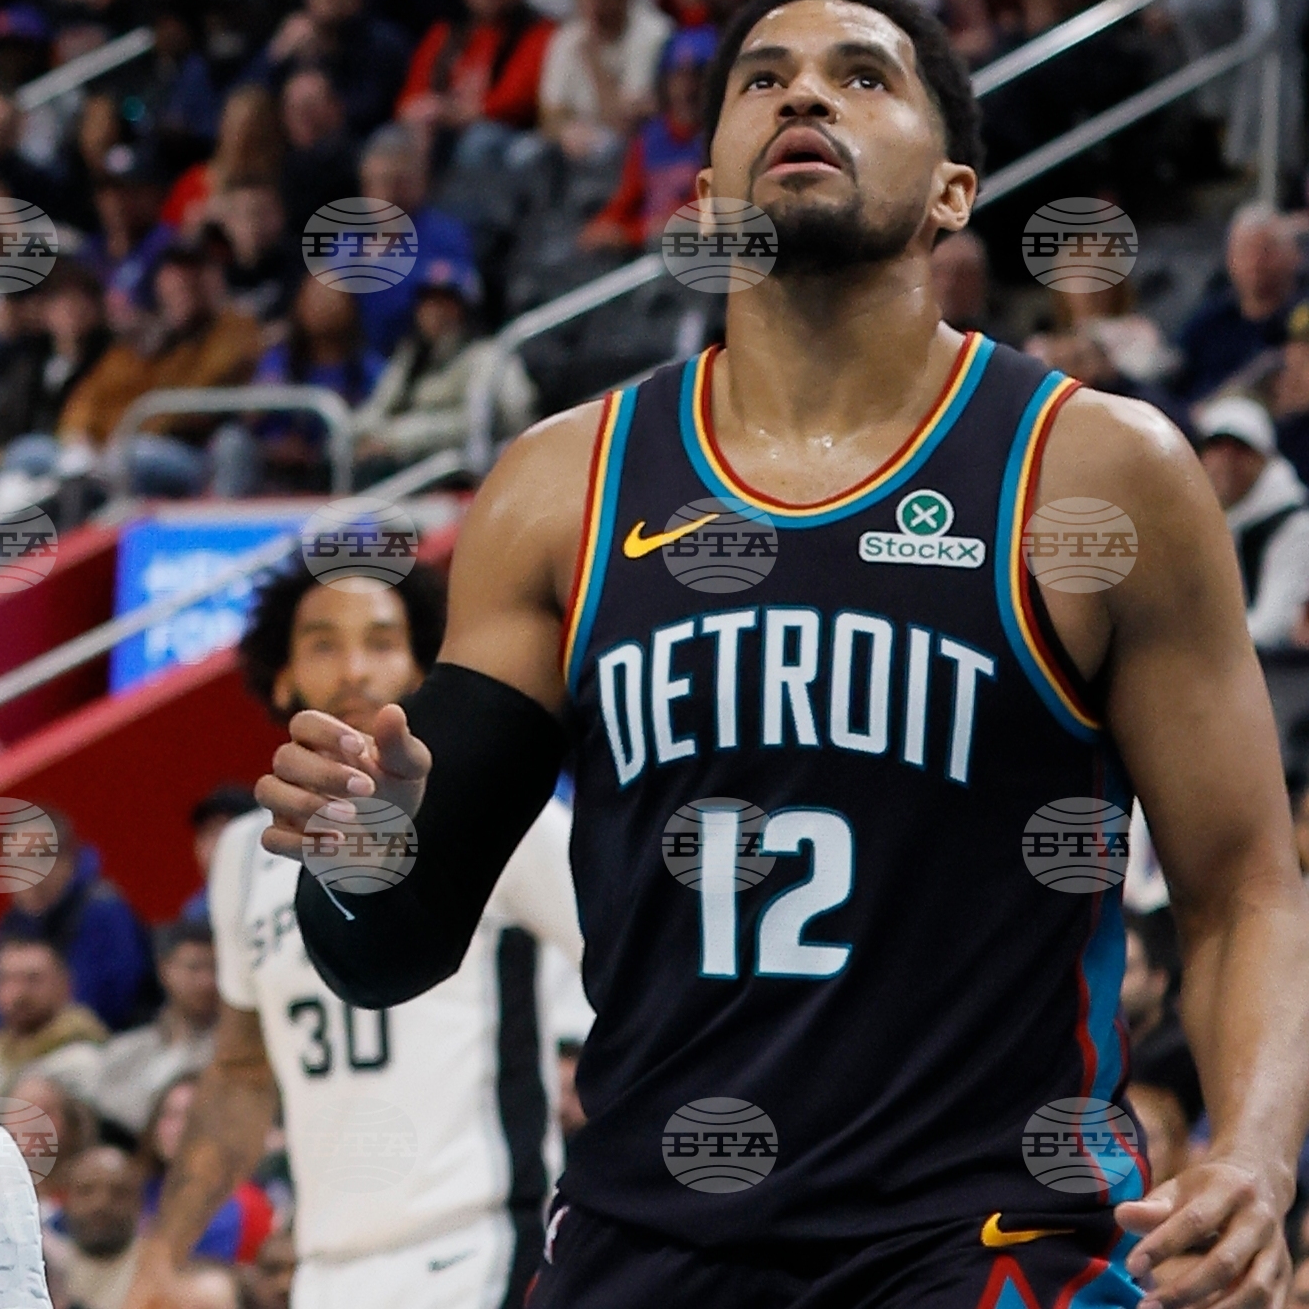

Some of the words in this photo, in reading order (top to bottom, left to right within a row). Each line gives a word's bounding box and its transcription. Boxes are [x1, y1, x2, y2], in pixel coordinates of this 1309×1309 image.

[864, 536, 980, 563] StockX
[597, 606, 995, 788] DETROIT
[698, 805, 855, 980] 12
[287, 995, 391, 1077] 30
